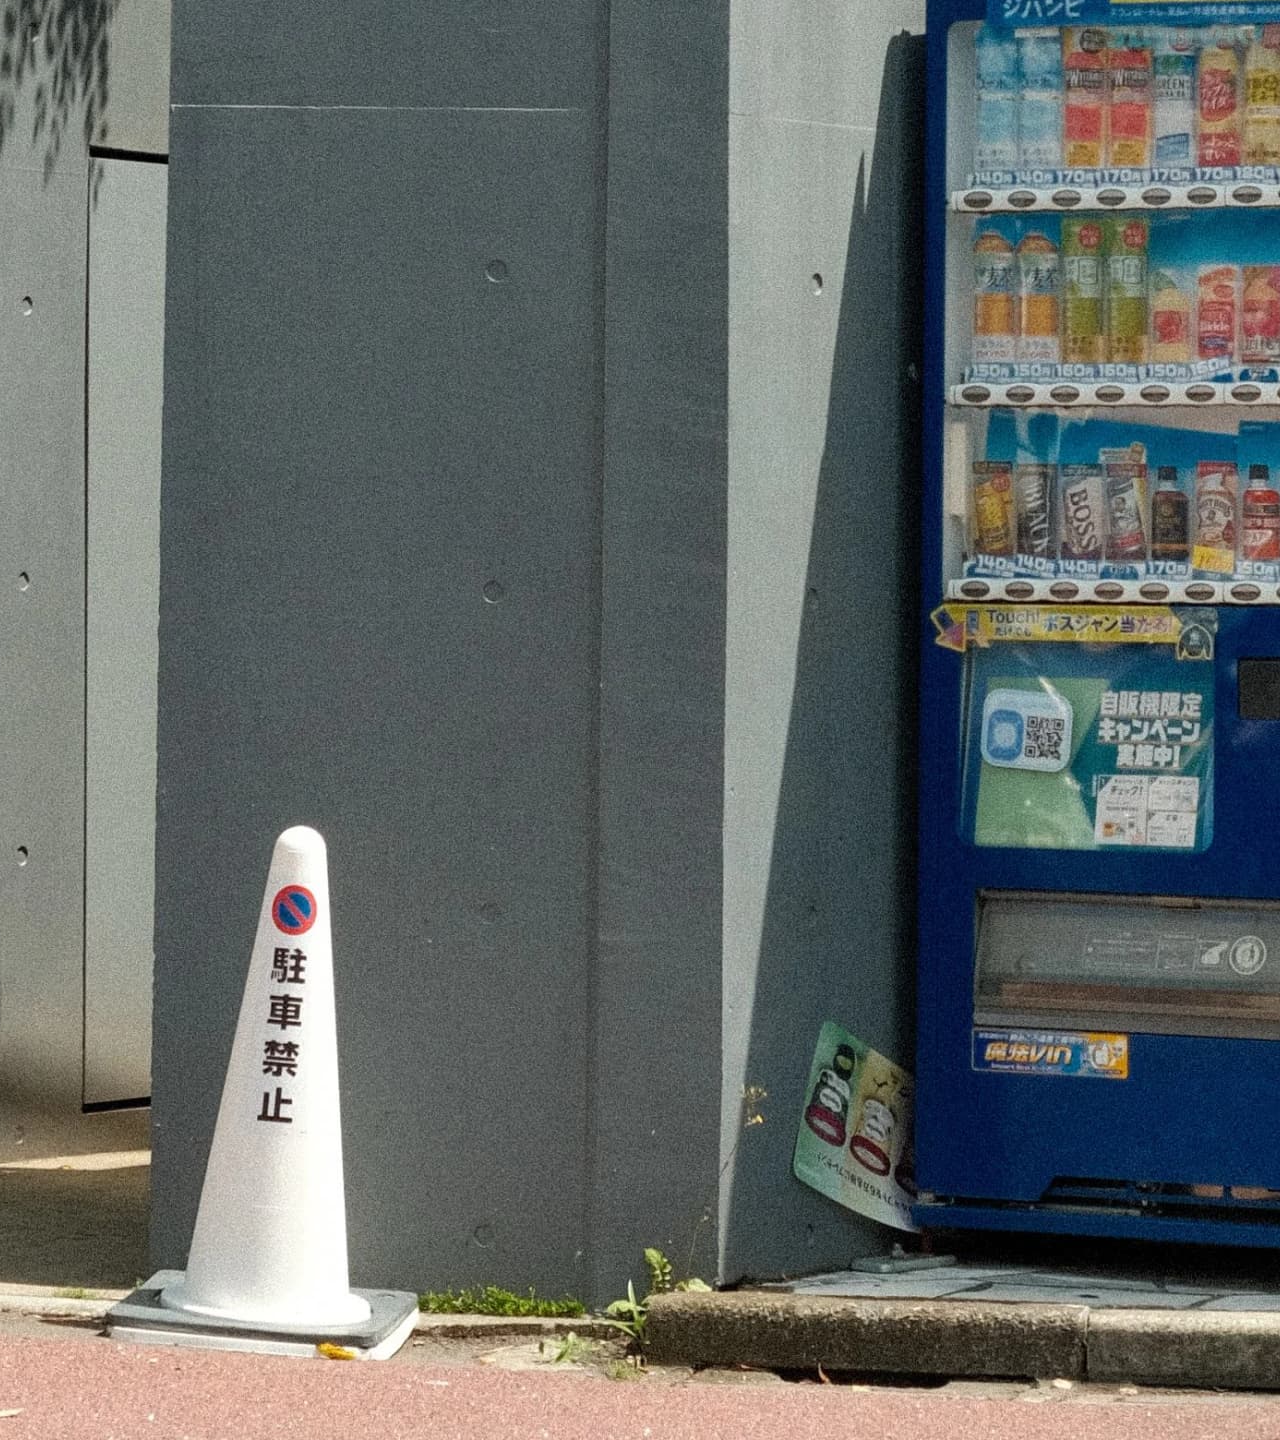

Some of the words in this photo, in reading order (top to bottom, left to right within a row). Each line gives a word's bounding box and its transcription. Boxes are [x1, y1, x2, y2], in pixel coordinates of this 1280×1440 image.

[1070, 486, 1098, 552] BOSS
[986, 609, 1040, 624] Touch!
[1100, 690, 1203, 719] 自販機限定
[1098, 719, 1200, 743] キャンペーン
[256, 947, 307, 1124] 駐車禁止
